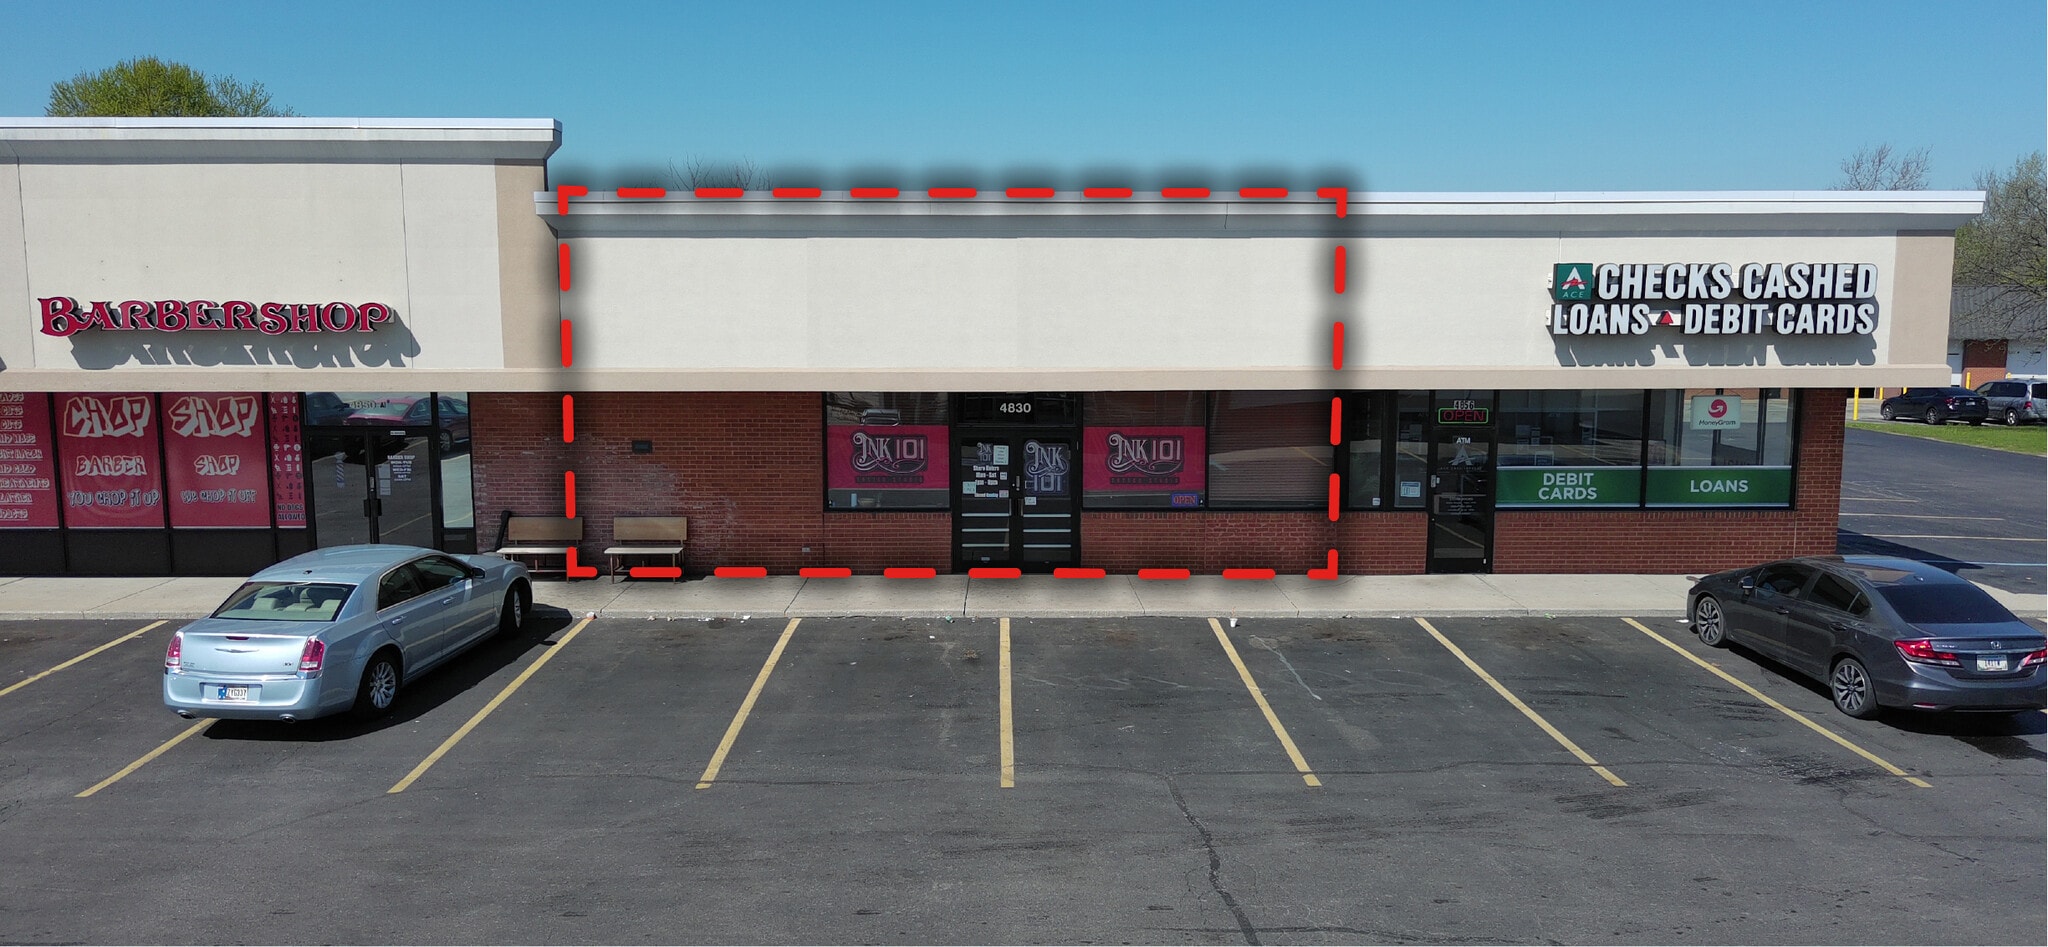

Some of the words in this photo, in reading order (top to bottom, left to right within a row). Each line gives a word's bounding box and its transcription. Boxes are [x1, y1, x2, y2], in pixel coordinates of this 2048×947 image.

[1597, 262, 1734, 300] CHECKS
[1742, 262, 1878, 300] CASHED
[1562, 290, 1584, 298] ACE
[38, 296, 391, 337] BARBERSHOP
[1553, 303, 1651, 336] LOANS
[1682, 303, 1770, 335] DEBIT
[1776, 303, 1876, 336] CARDS
[999, 402, 1032, 414] 4830
[1454, 400, 1475, 409] 4856
[63, 396, 152, 437] CHOP
[168, 396, 258, 437] SHOP
[1443, 410, 1486, 421] OPEN
[852, 432, 894, 467] INK
[896, 438, 925, 460] 101
[1026, 441, 1064, 472] INK
[1108, 433, 1149, 467] INK
[1152, 439, 1181, 461] 101
[75, 455, 147, 476] BARBER
[193, 455, 241, 475] SHOP
[1542, 473, 1595, 487] DEBIT
[1690, 480, 1749, 493] LOANS
[68, 490, 93, 506] YOU
[95, 489, 128, 506] CHOP
[129, 488, 142, 507] IT
[143, 488, 160, 506] UP
[200, 488, 226, 504] CHOP
[1173, 495, 1198, 505] OPEN
[1538, 486, 1598, 501] CARDS
